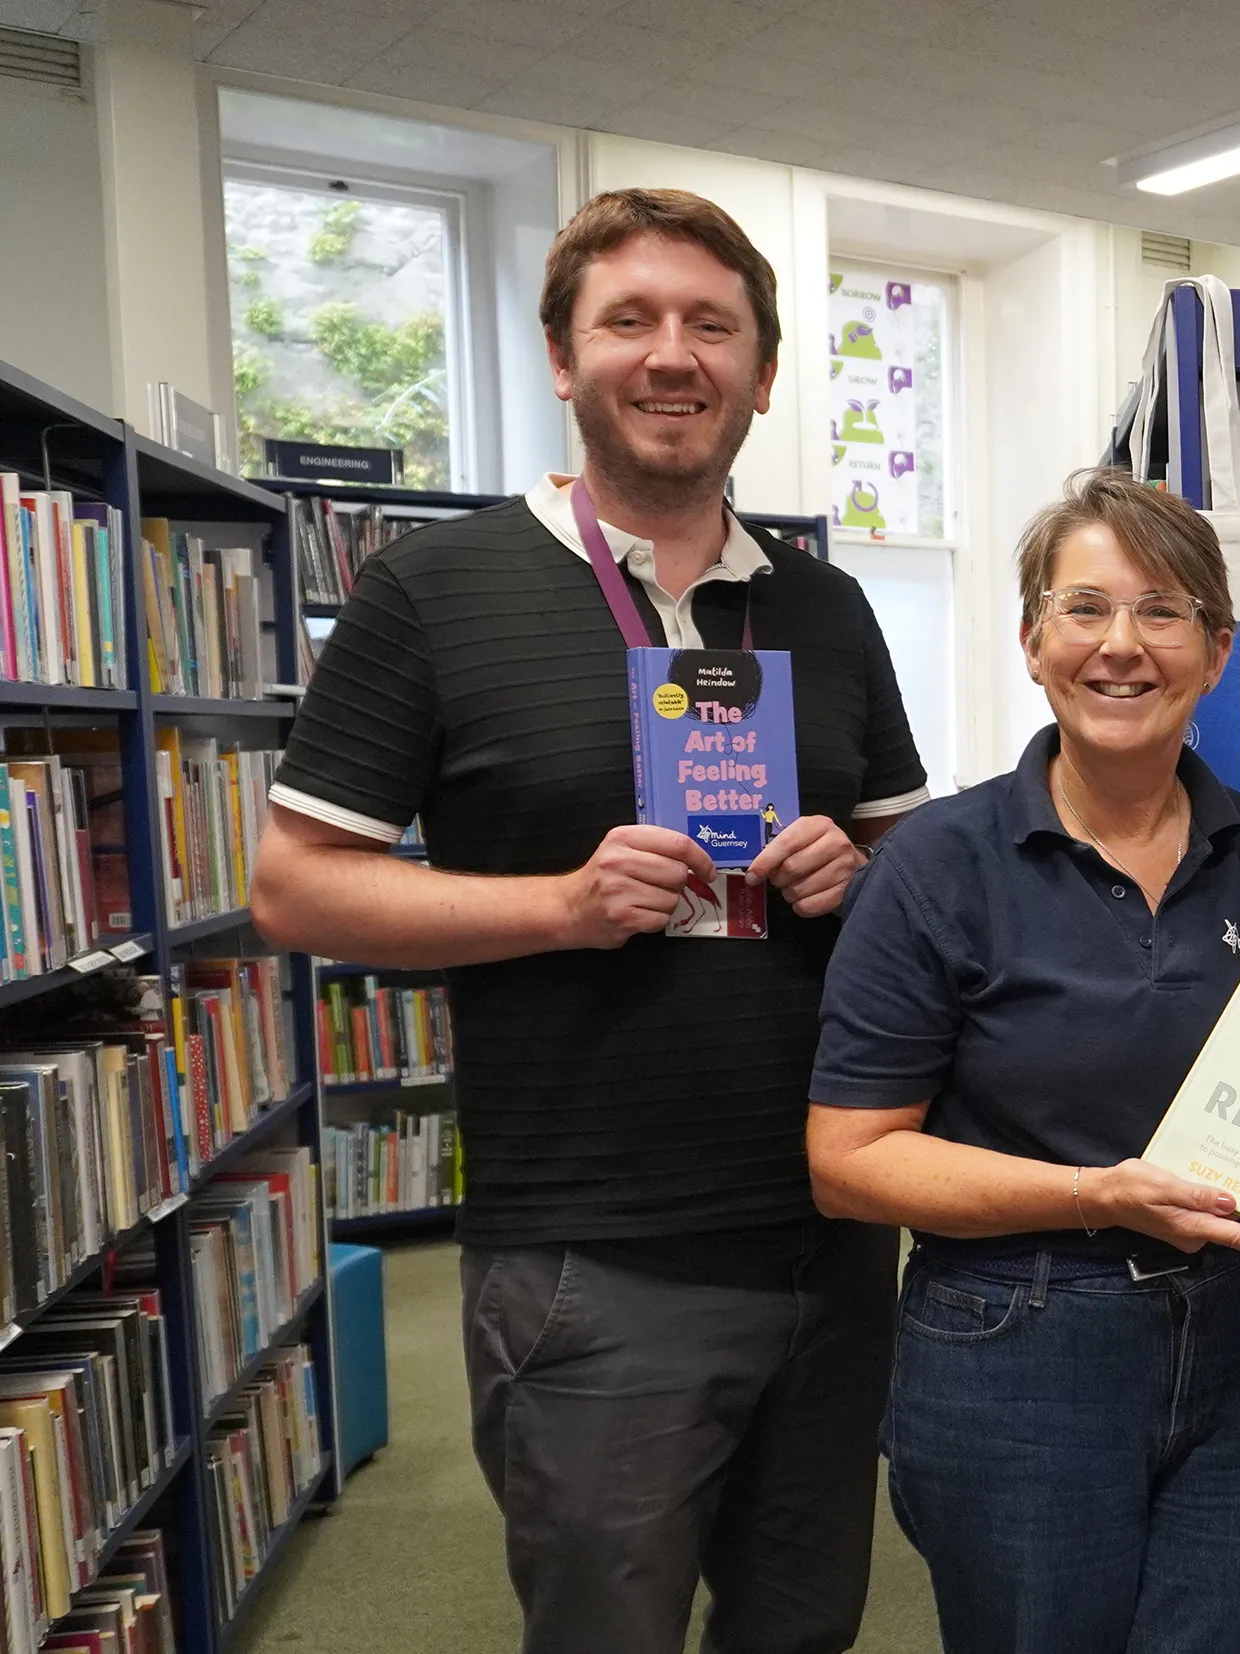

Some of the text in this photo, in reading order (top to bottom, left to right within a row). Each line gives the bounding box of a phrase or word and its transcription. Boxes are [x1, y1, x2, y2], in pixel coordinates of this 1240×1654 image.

[841, 288, 881, 302] BORROW
[848, 376, 878, 386] GROW
[299, 456, 370, 470] ENGINEERING
[848, 460, 881, 470] RETURN
[698, 667, 733, 677] Matilda
[696, 679, 736, 687] Heindow
[695, 701, 742, 724] The
[633, 712, 641, 752] Feeling
[685, 730, 756, 753] Art of
[677, 759, 768, 788] Feeling
[685, 789, 762, 812] Better
[710, 831, 736, 840] mind
[711, 839, 748, 849] Guernsey
[1206, 1135, 1220, 1146] The
[1221, 1141, 1239, 1156] busy
[1200, 1144, 1208, 1152] to
[1208, 1149, 1240, 1168] pausing
[1189, 1161, 1222, 1182] SUZY
